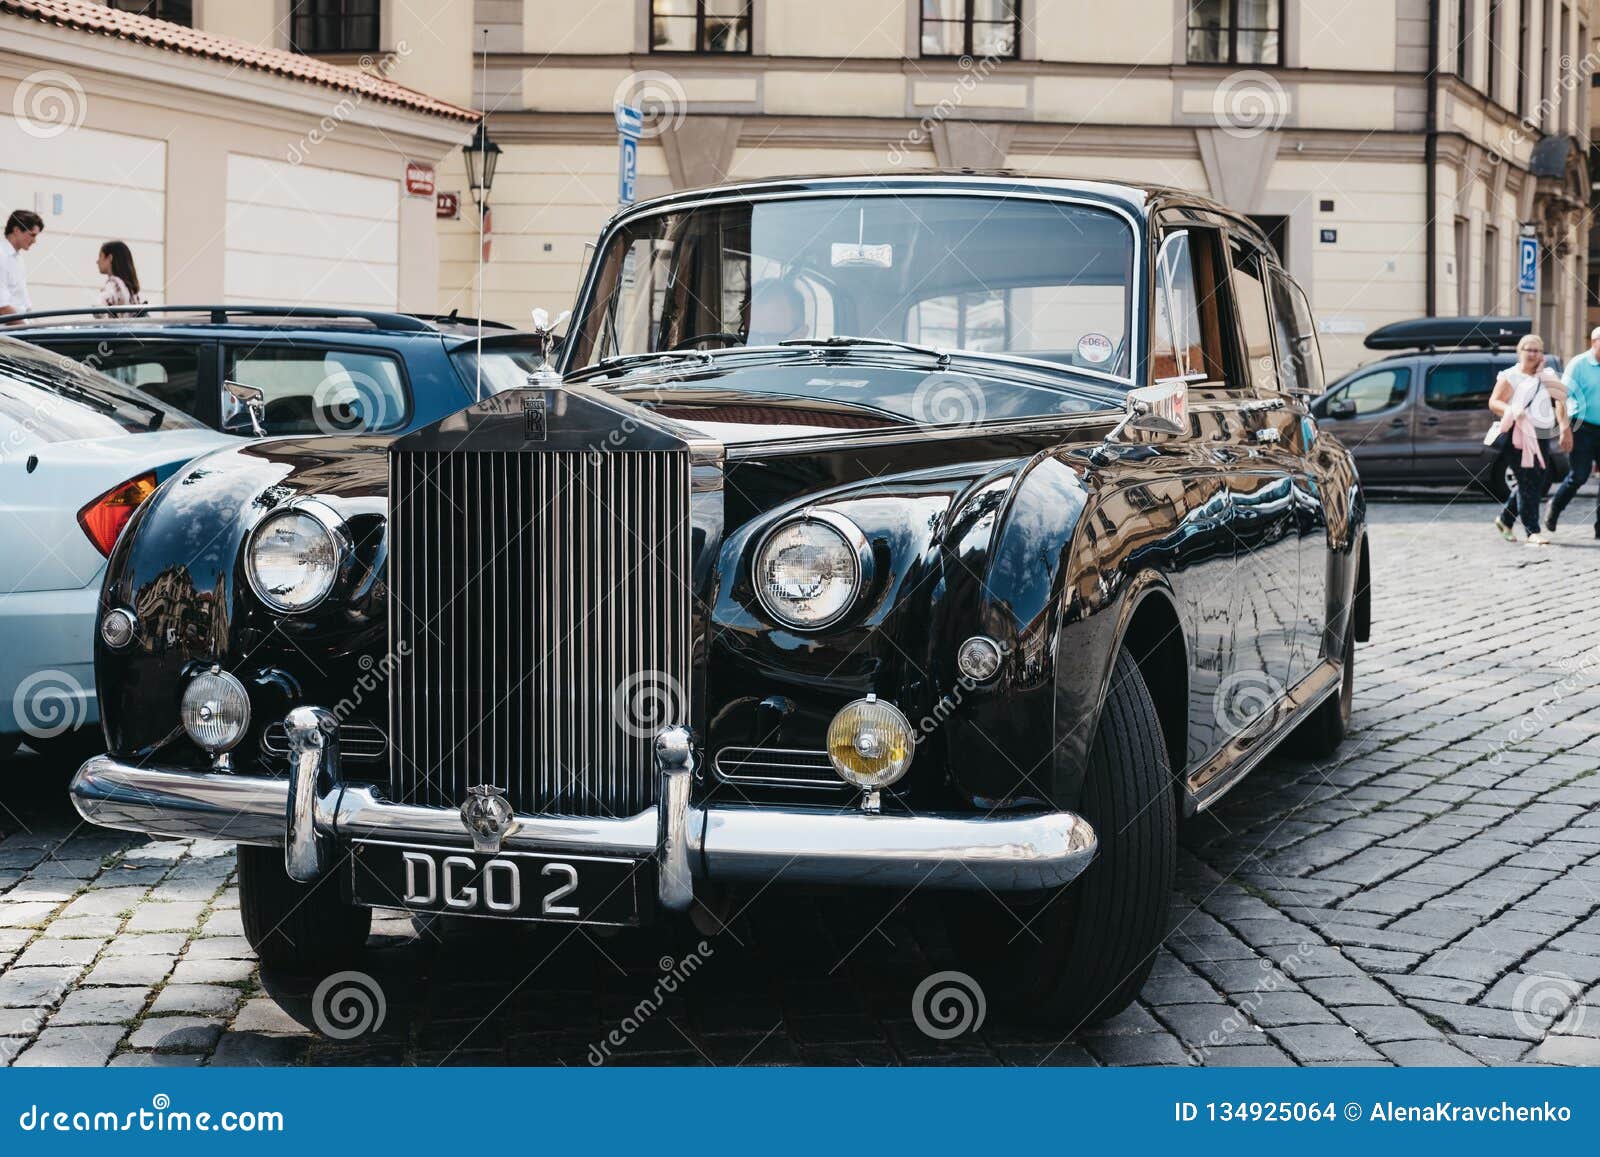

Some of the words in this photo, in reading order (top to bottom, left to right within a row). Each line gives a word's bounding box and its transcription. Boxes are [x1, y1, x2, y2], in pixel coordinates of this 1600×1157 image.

[1523, 245, 1534, 275] P
[402, 851, 521, 912] DGO
[541, 862, 580, 917] 2
